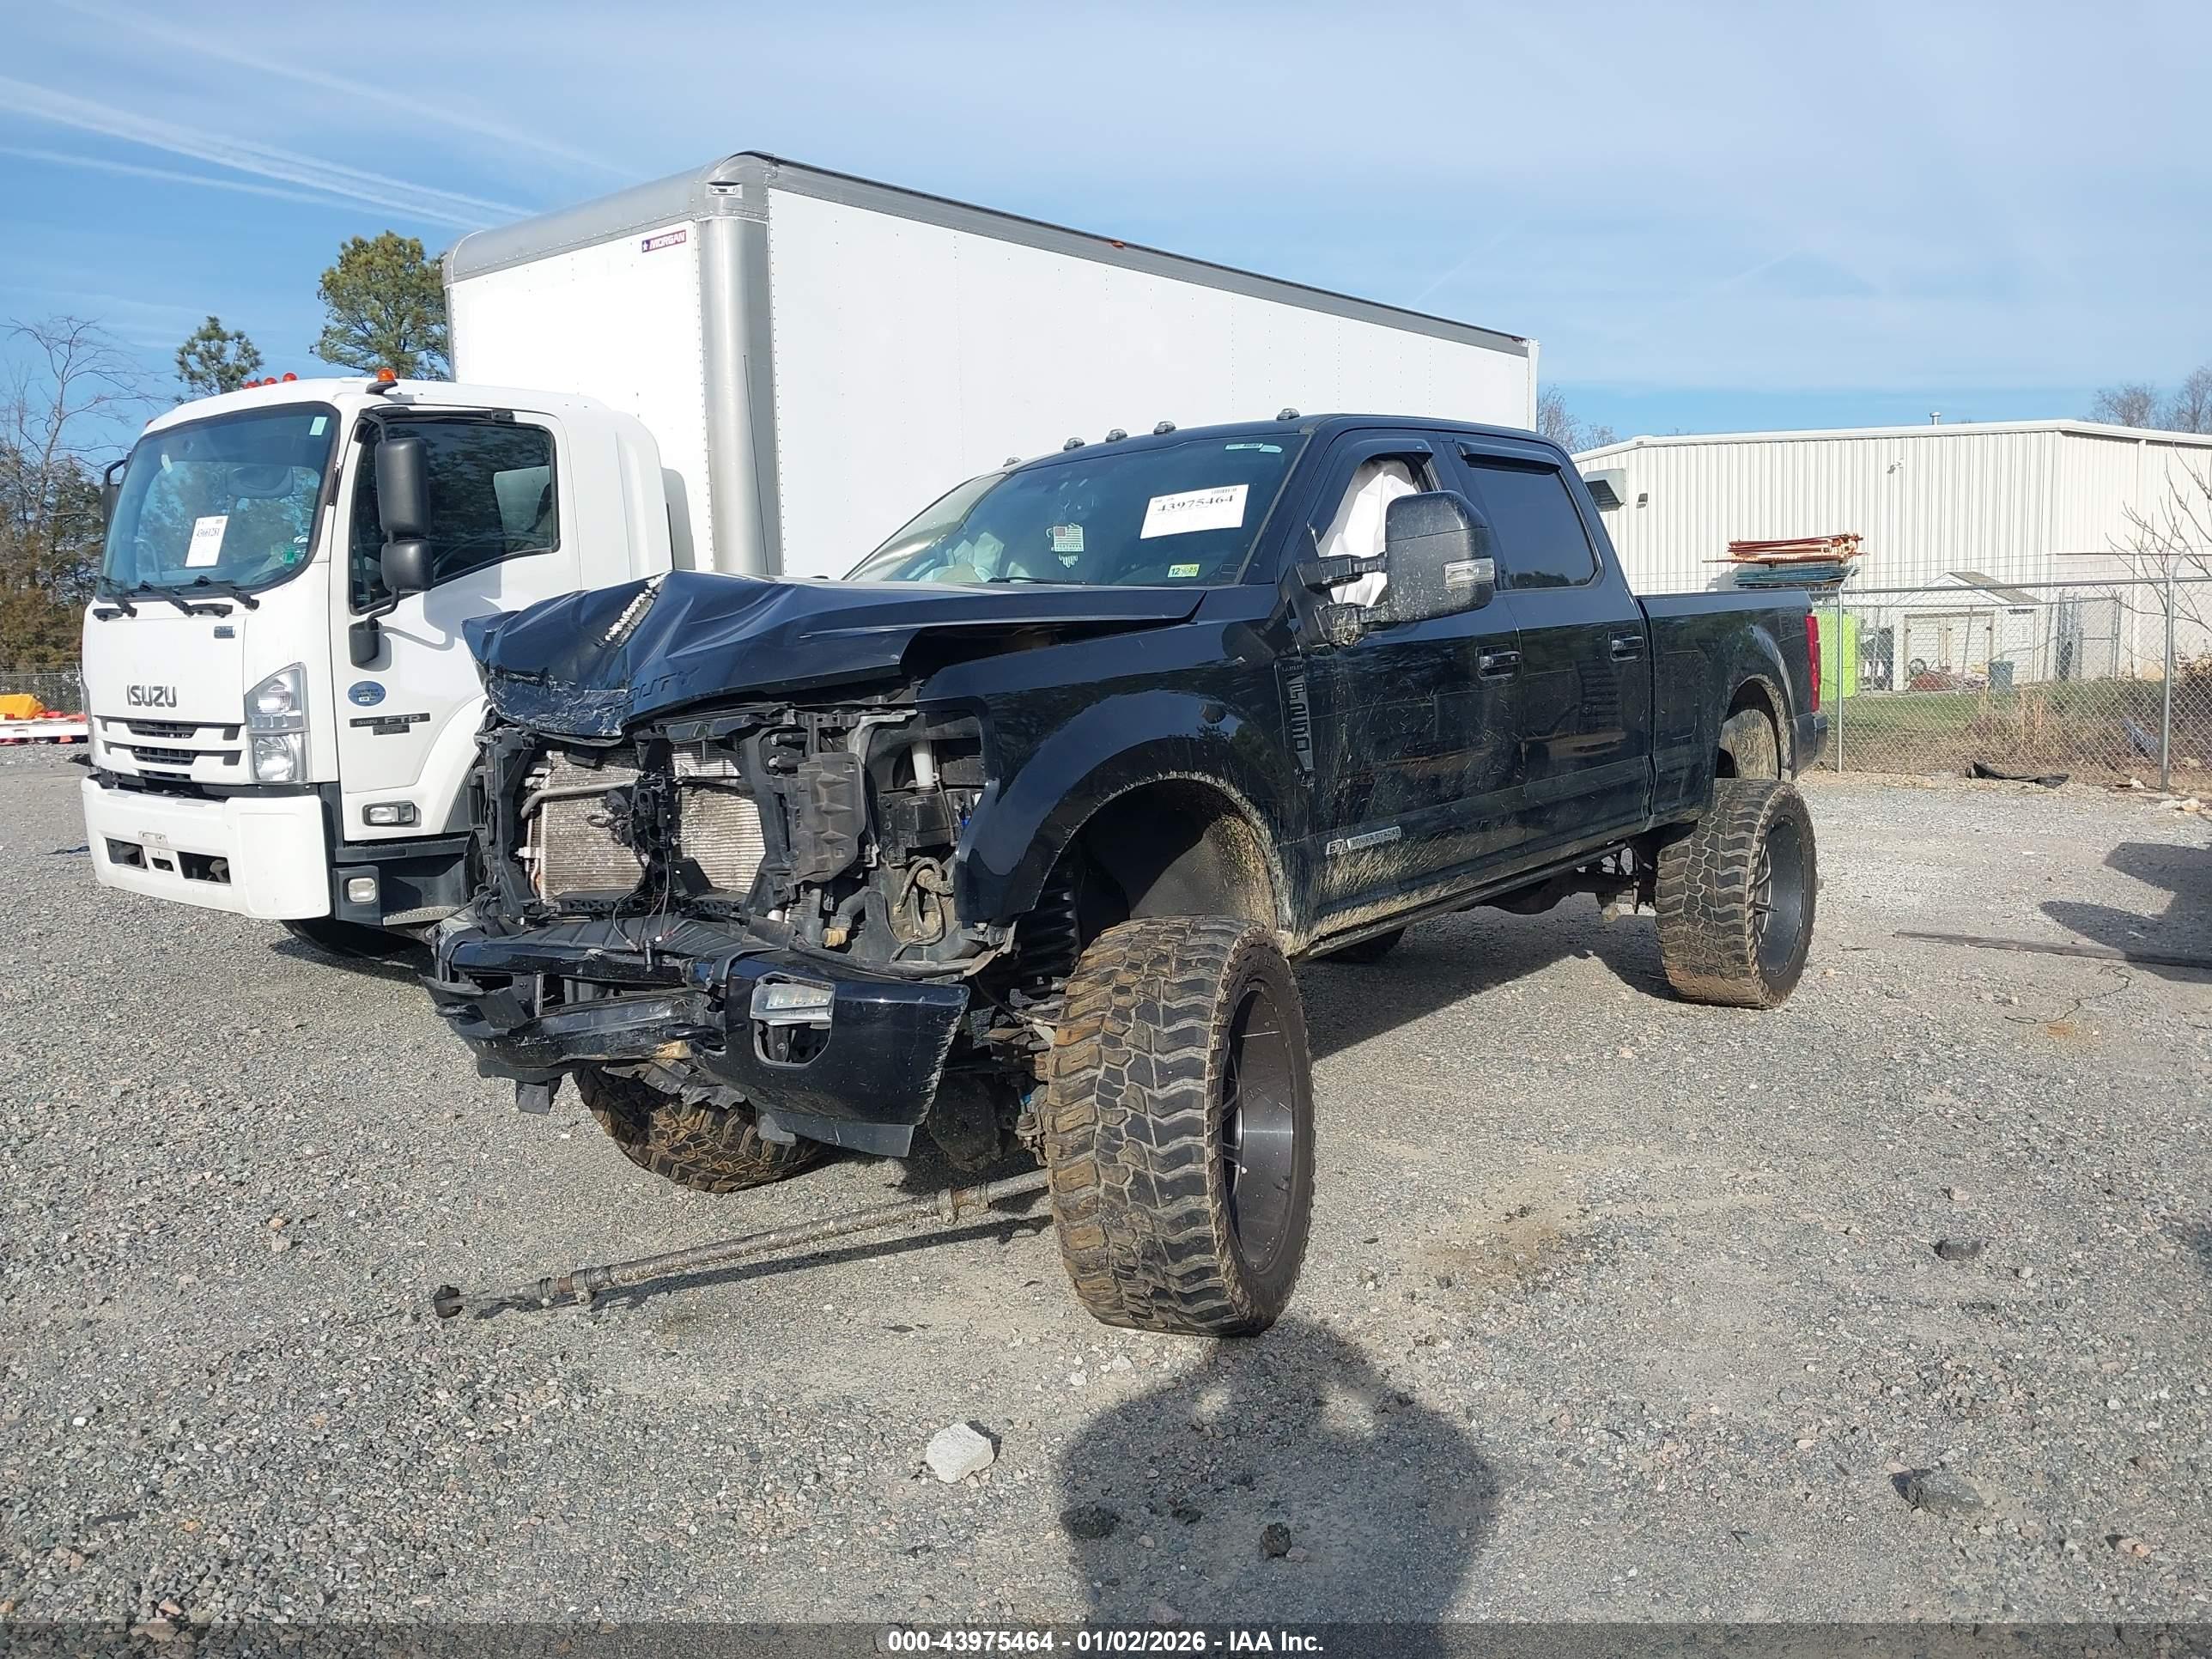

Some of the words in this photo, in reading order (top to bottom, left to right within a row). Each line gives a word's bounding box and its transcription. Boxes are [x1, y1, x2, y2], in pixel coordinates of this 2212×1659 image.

[650, 232, 685, 249] MORGAN
[1158, 495, 1233, 511] 43975464
[127, 685, 177, 708] ISUZU
[384, 714, 420, 724] FTR
